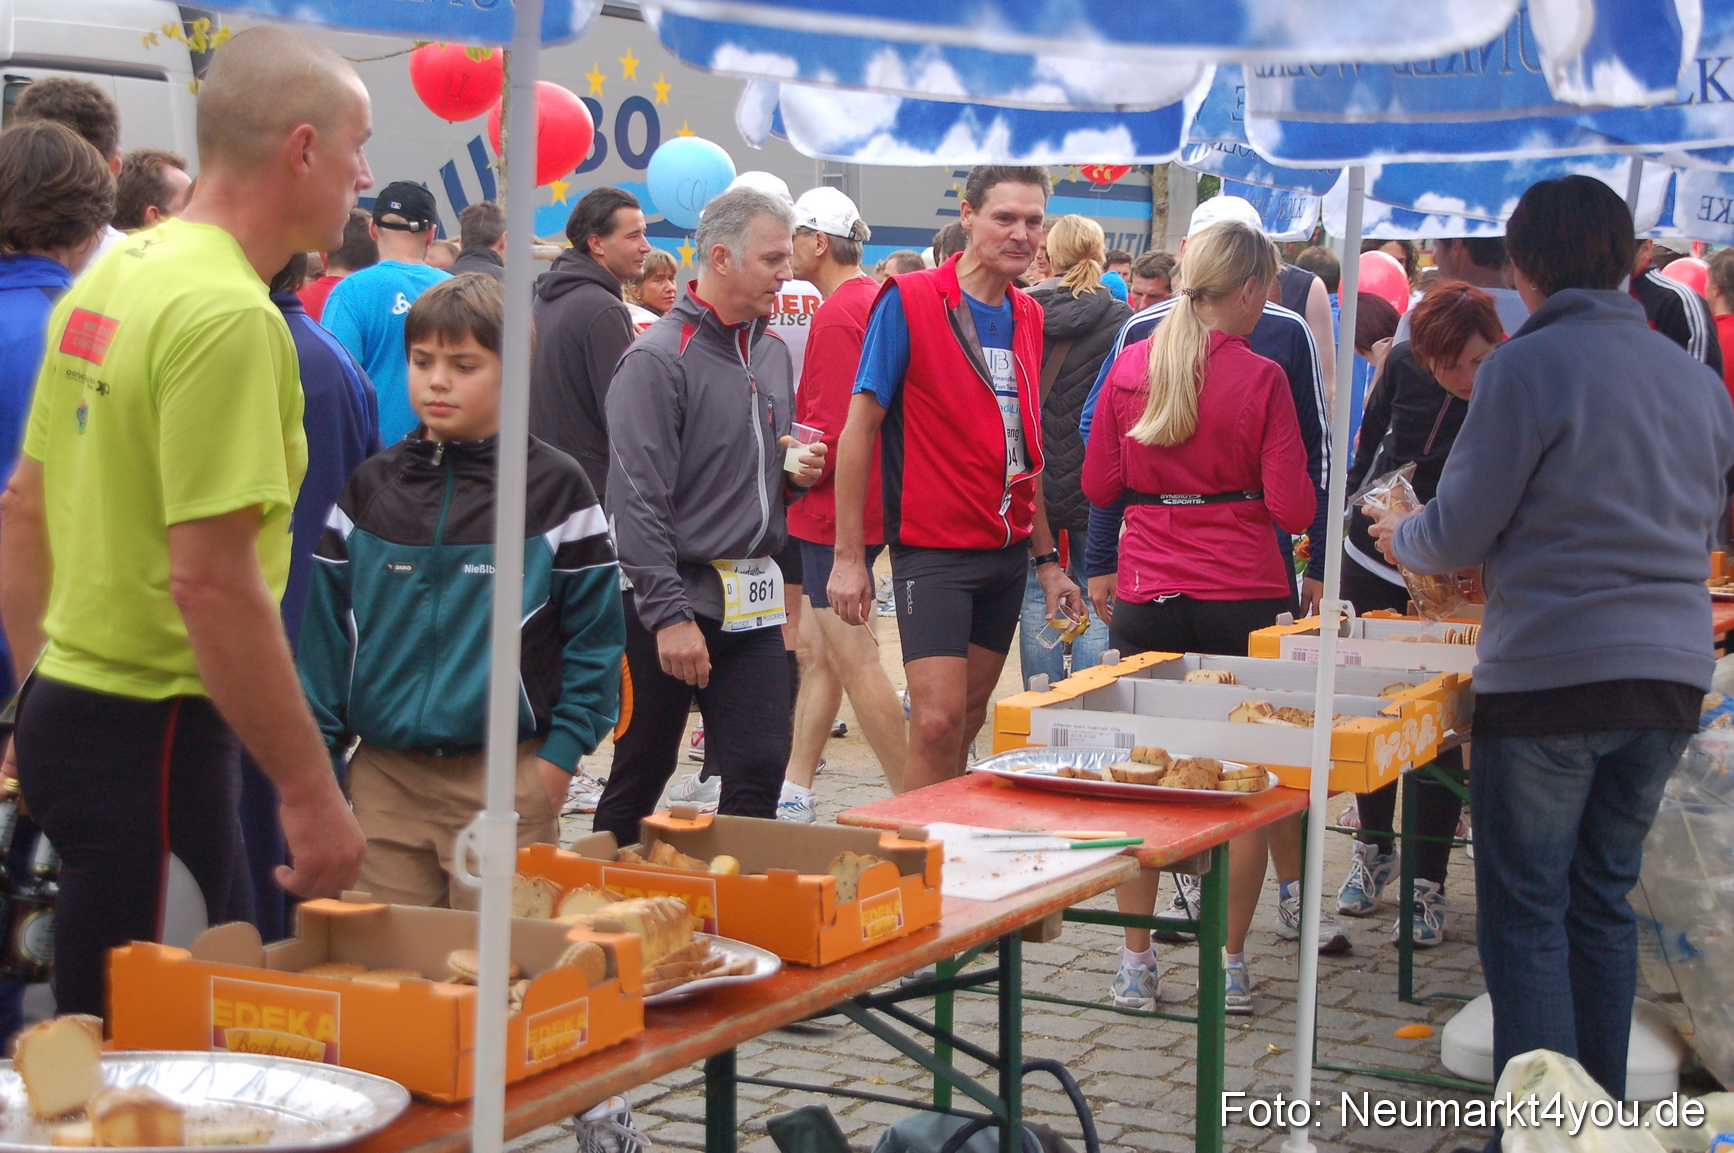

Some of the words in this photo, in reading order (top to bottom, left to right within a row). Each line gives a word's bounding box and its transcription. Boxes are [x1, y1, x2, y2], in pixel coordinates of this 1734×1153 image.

[749, 578, 774, 603] 861
[213, 998, 338, 1042] EDEKA
[529, 1012, 588, 1047] EDEKA
